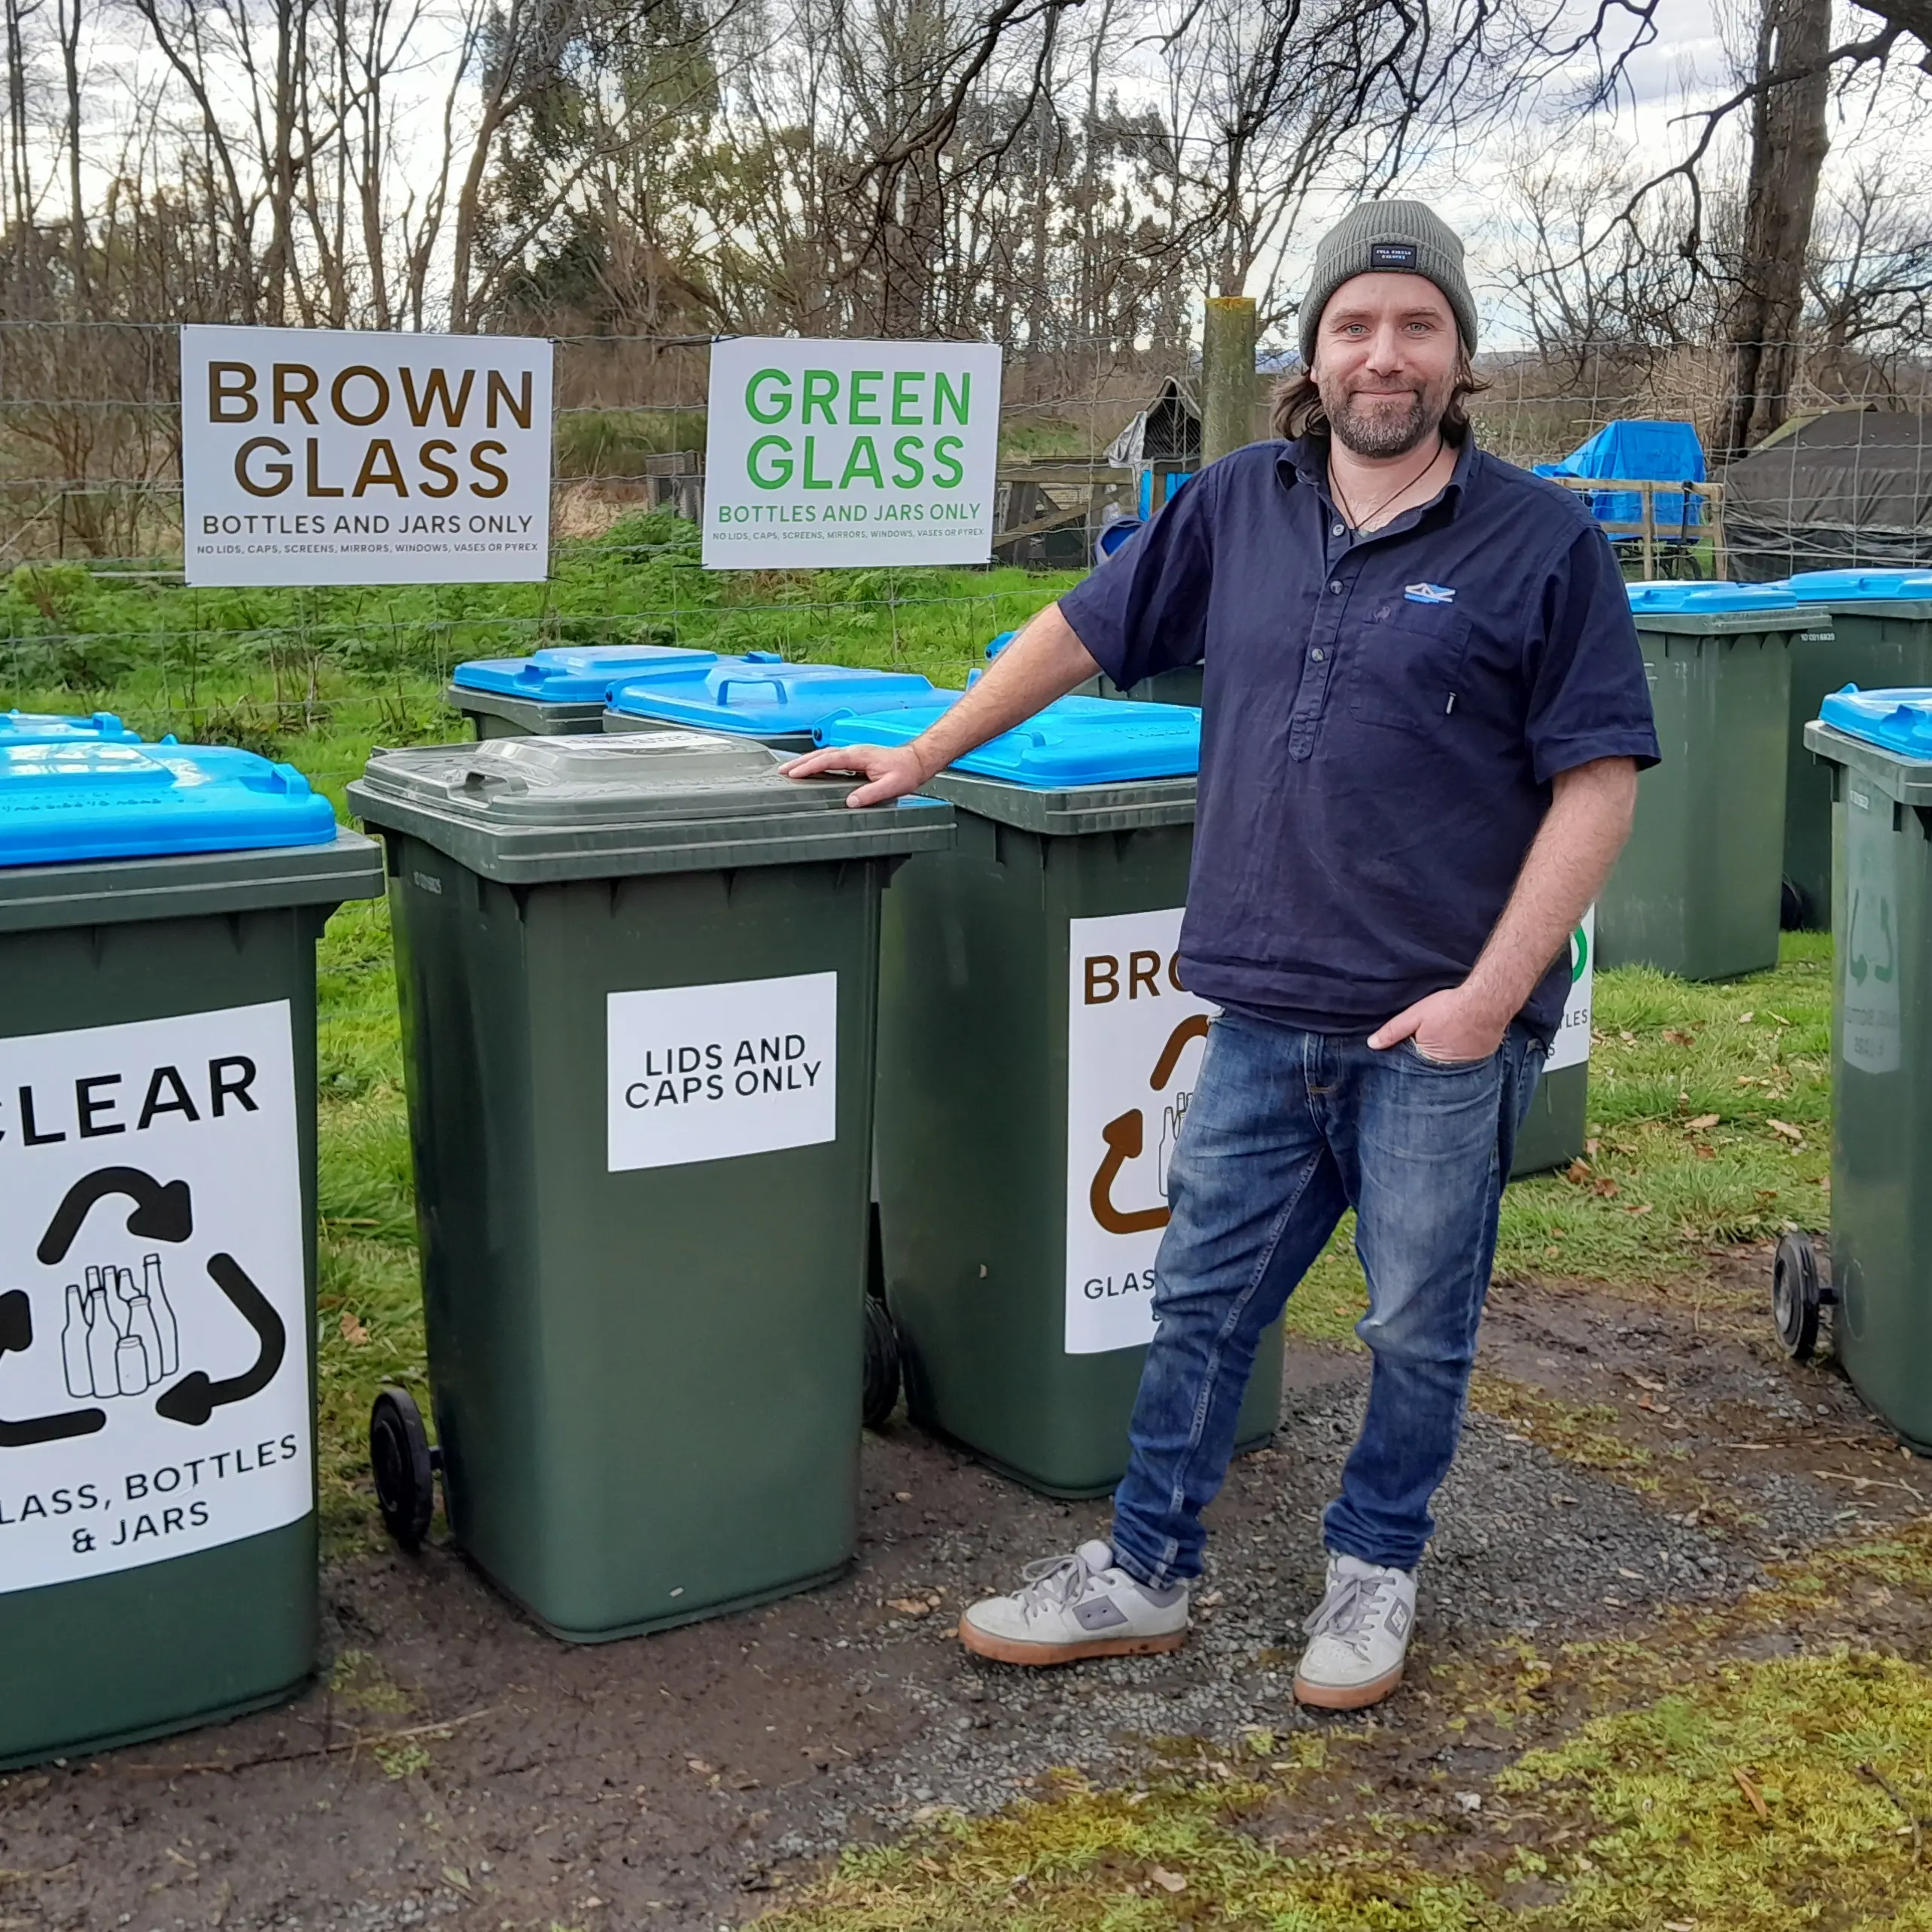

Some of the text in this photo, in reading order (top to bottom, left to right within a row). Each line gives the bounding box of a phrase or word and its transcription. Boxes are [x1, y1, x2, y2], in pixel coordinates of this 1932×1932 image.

[208, 361, 533, 429] BROWN
[744, 368, 971, 425] GREEN
[234, 436, 509, 498] GLASS
[746, 434, 964, 490] GLASS
[203, 515, 533, 534] BOTTLES AND JARS ONLY
[713, 532, 726, 540] NO
[729, 532, 750, 541] LIDS,
[753, 531, 780, 540] CAPS,
[782, 531, 825, 540] SCREENS,
[827, 530, 869, 539] MIRRORS,
[871, 529, 915, 538] WINDOWS,
[957, 528, 984, 536] PYREX
[718, 503, 981, 523] BOTTLES AND JARS ONLY
[197, 543, 538, 555] NO LIDS, CAPS, SCREENS, MIRRORS, WINDOWS, VASES OR PYREX
[646, 1034, 805, 1076] LIDS AND
[0, 1055, 260, 1146] LEAR
[625, 1060, 822, 1109] CAPS ONLY
[1084, 1269, 1155, 1300] GLAS
[0, 1434, 297, 1525] LASS, BOTTLES
[72, 1501, 209, 1553] & JARS
